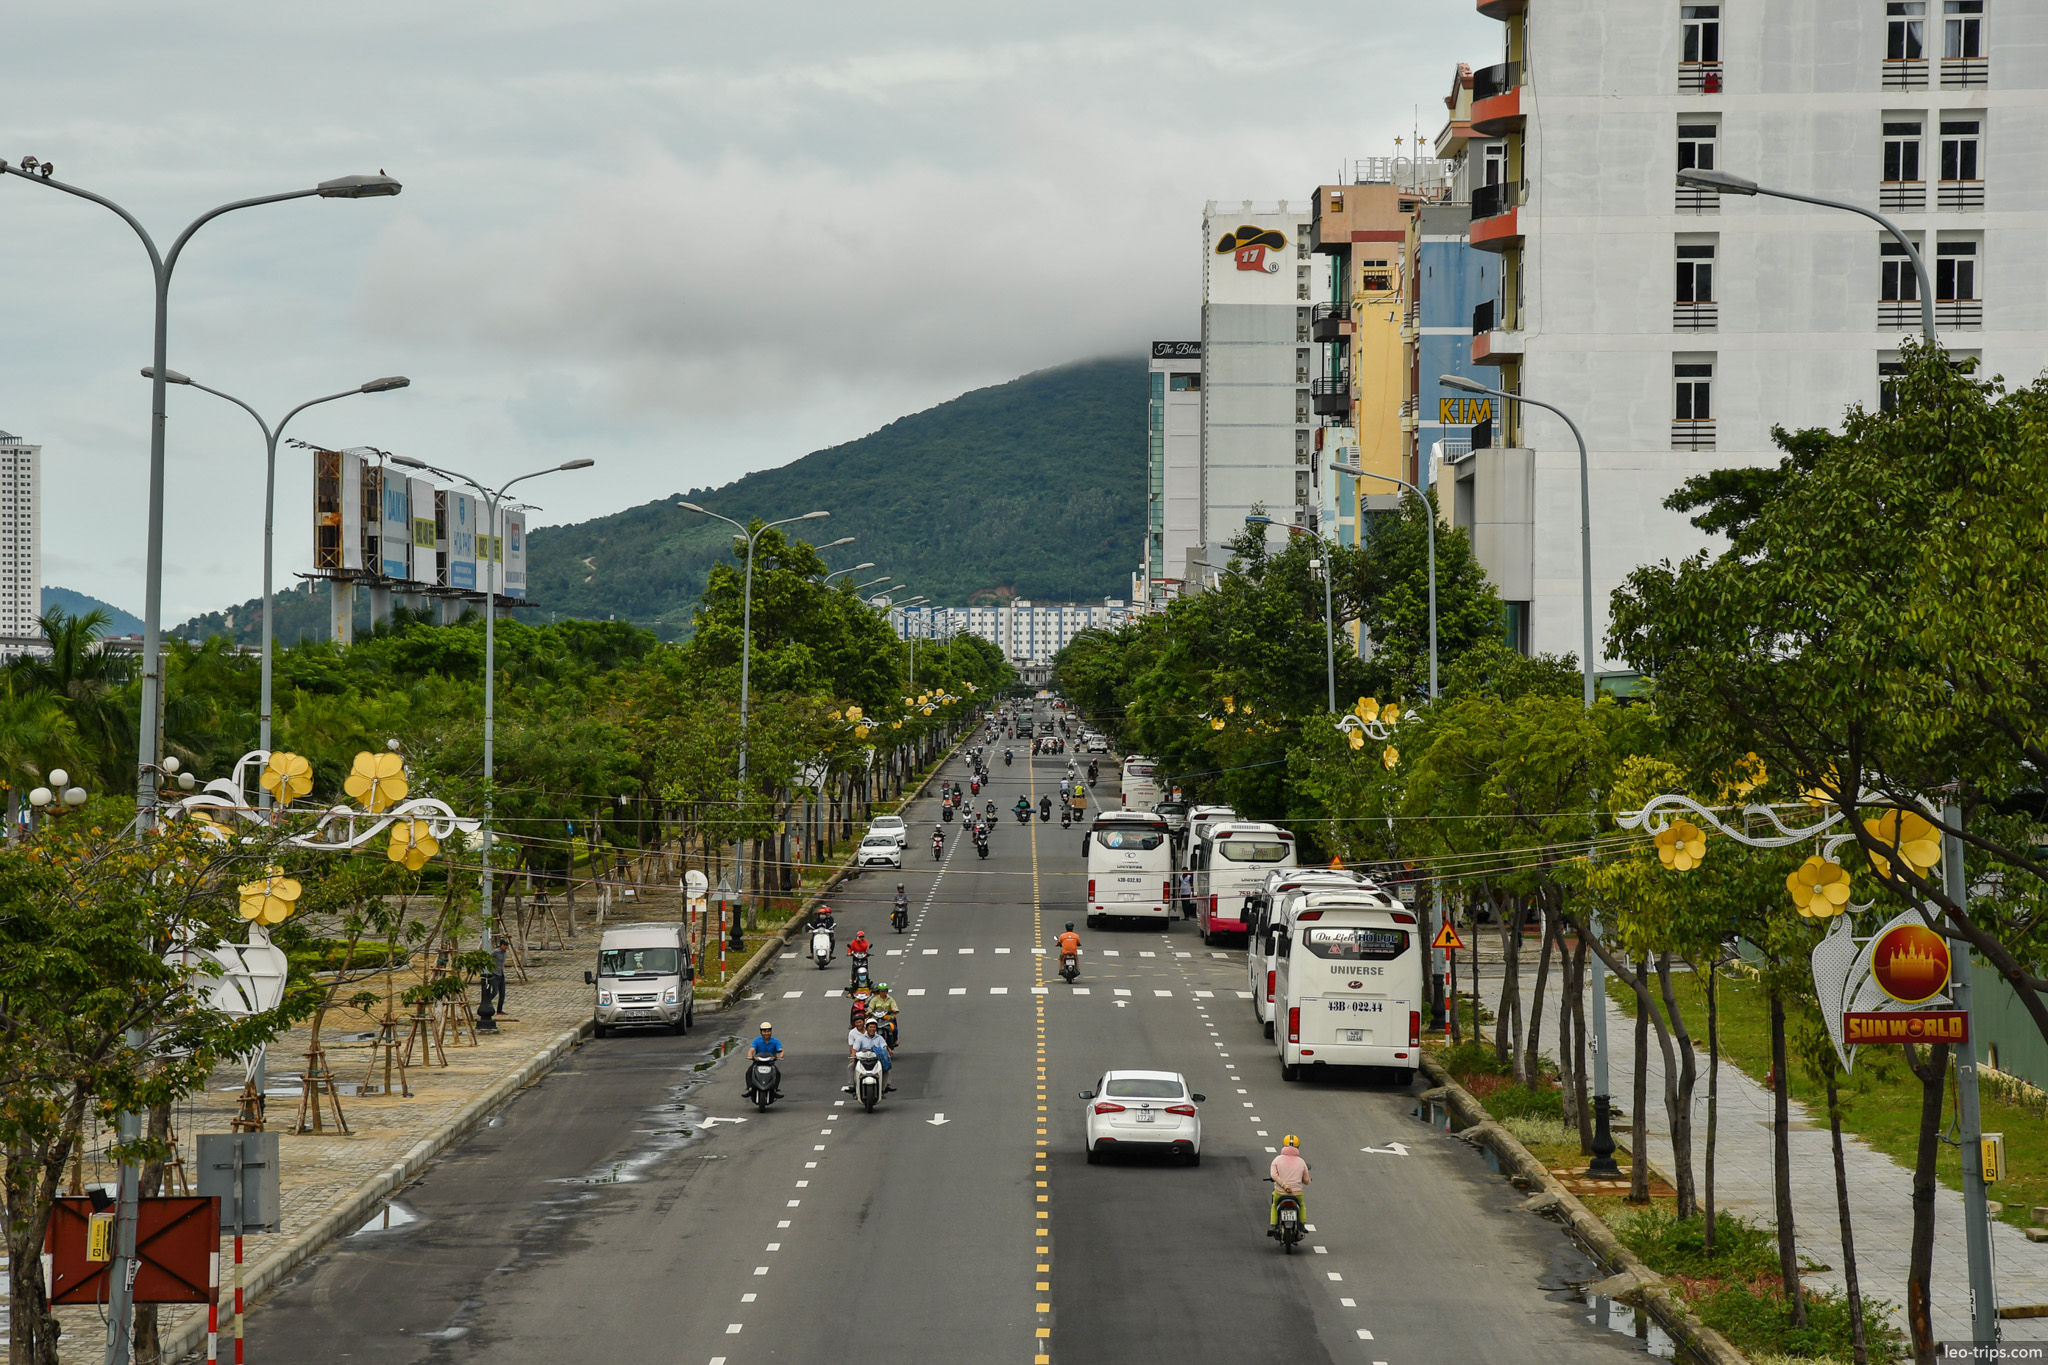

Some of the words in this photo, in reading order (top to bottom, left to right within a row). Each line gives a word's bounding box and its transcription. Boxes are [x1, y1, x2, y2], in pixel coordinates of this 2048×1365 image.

[1242, 249, 1260, 263] 17
[1154, 343, 1174, 356] The
[1440, 398, 1491, 424] KIM
[1315, 932, 1331, 941] Du
[1330, 965, 1384, 976] UNIVERSE
[1328, 1001, 1345, 1012] 43B
